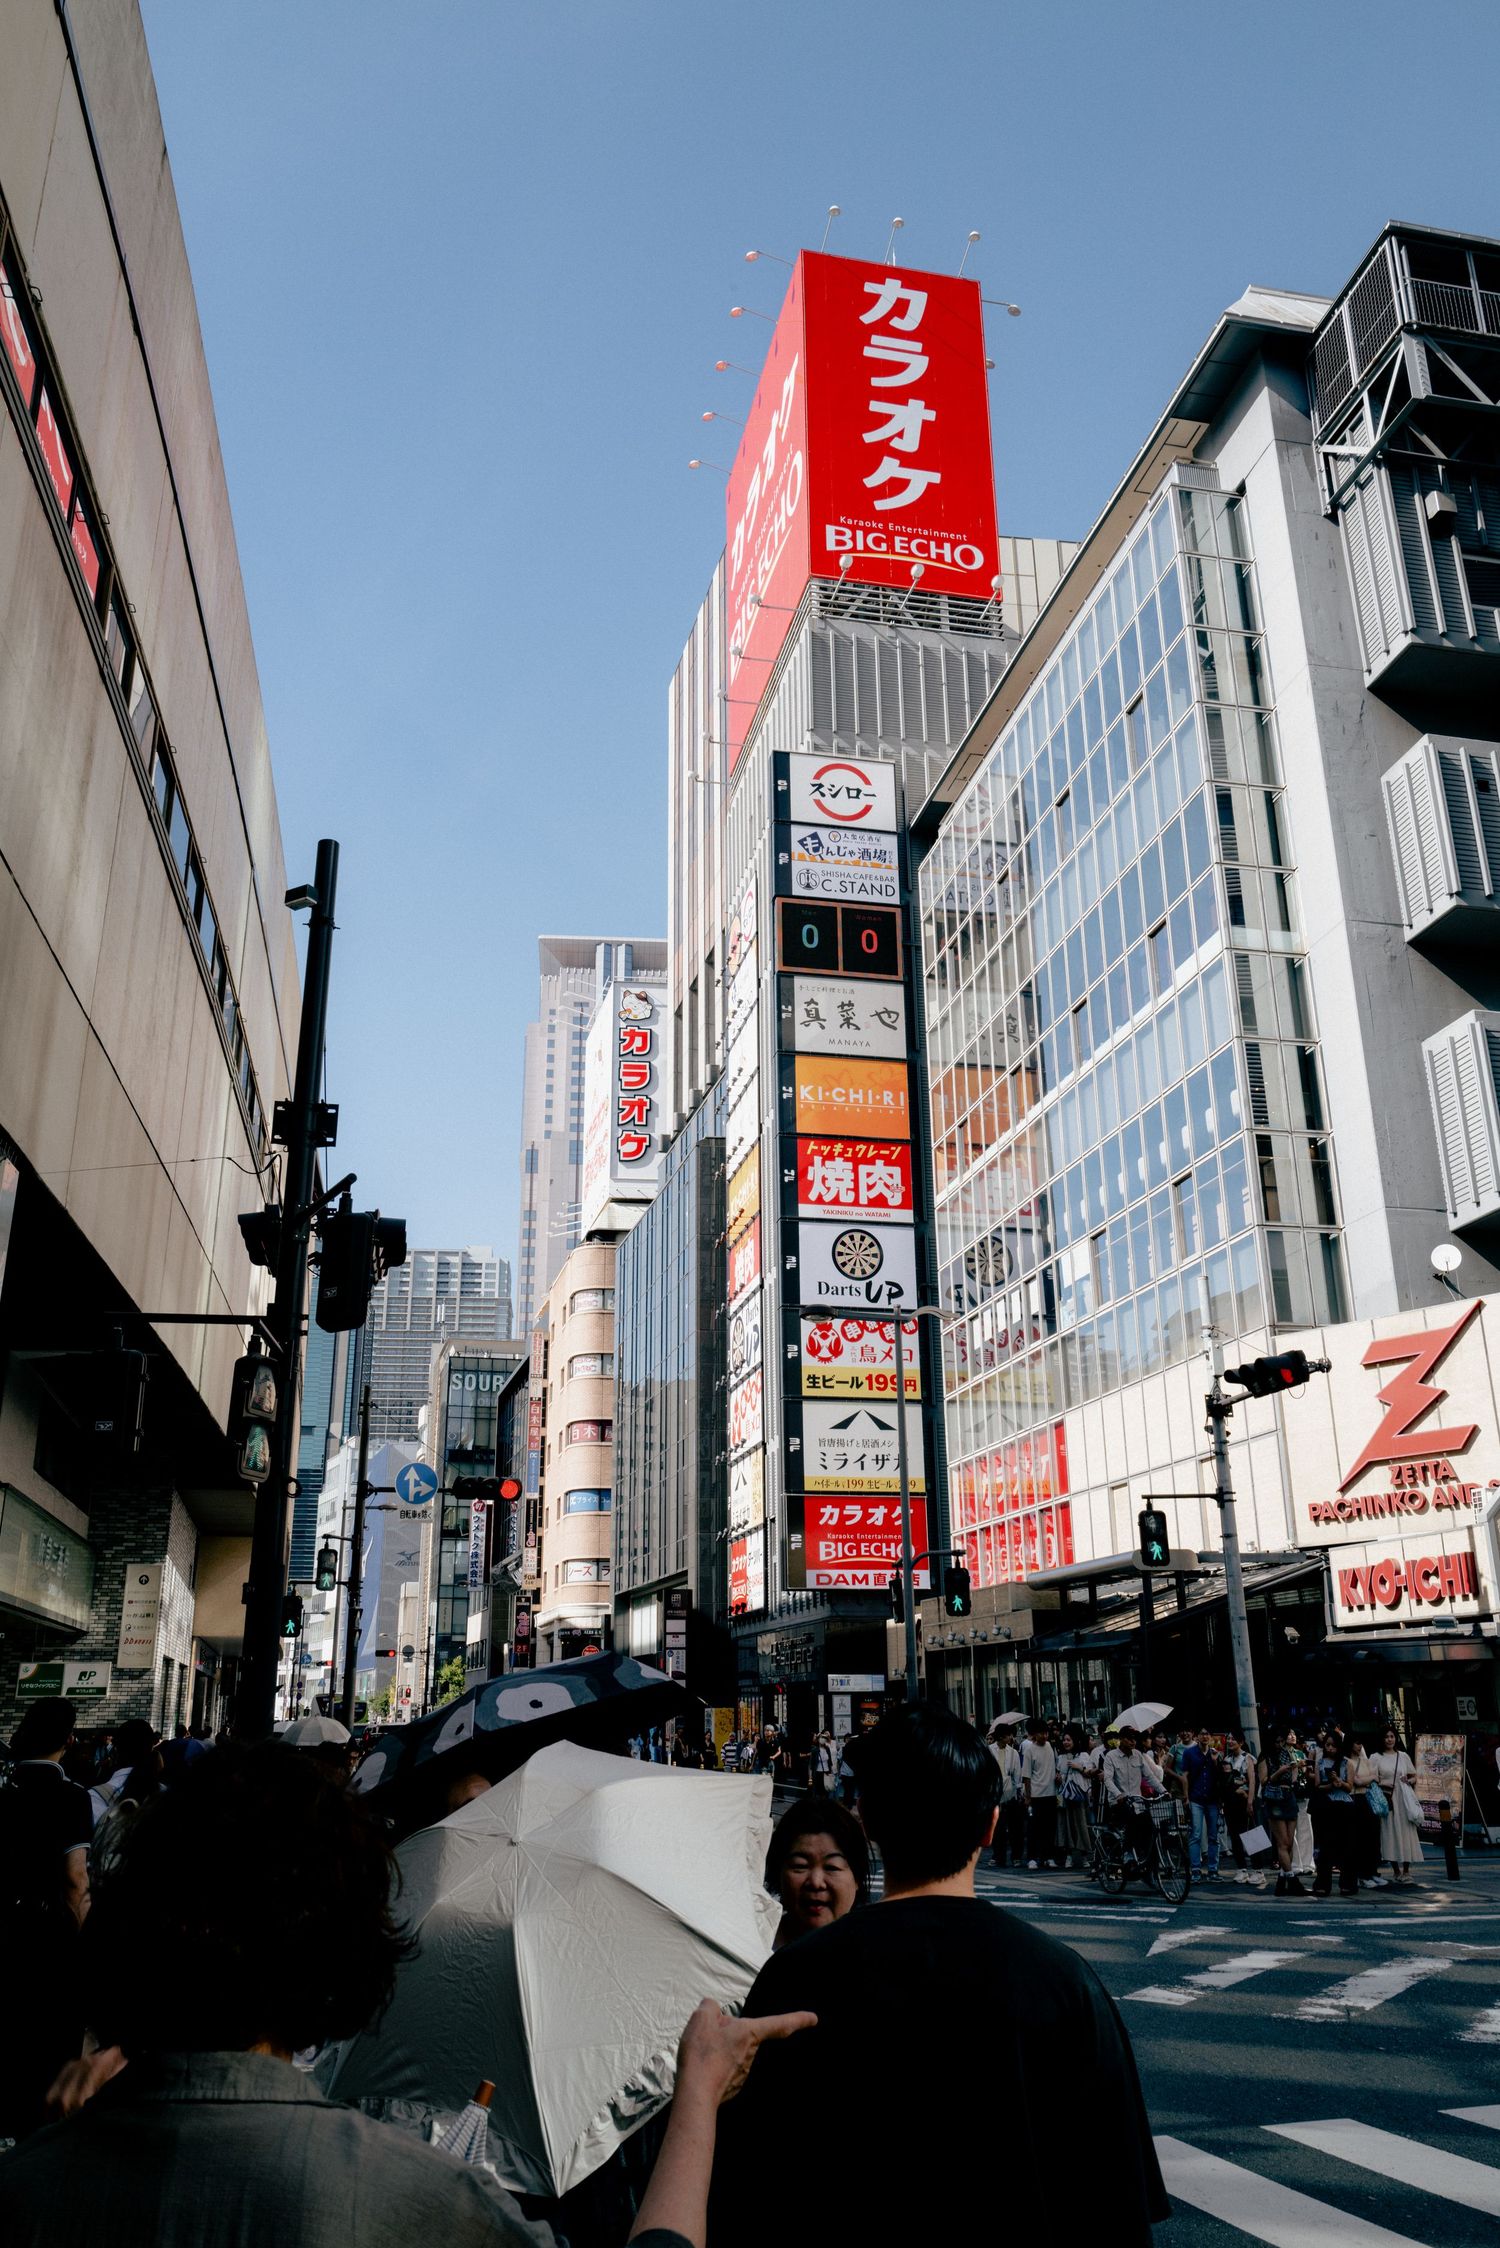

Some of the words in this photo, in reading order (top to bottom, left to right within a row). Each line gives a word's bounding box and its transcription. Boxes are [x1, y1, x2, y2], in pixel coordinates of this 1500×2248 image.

[858, 277, 942, 511] カラオケ
[731, 351, 799, 591] カラオケ
[839, 515, 884, 530] Karaoke
[888, 522, 968, 541] Entertainment
[826, 524, 888, 552] BIG
[894, 536, 985, 571] ECHO
[729, 577, 756, 687] BIG
[757, 450, 803, 595] ECHO
[808, 780, 878, 801] スシロー
[821, 869, 852, 880] SHISHA
[852, 873, 896, 883] CAFE&BAR
[821, 879, 896, 897] C.STAND
[801, 924, 819, 949] 0
[861, 929, 879, 954] 0
[828, 1038, 871, 1047] MANAYA
[617, 1025, 652, 1163] カラオケ
[806, 1141, 902, 1160] トッキュウレーン
[806, 1156, 904, 1206] 焼肉
[817, 1280, 862, 1297] Darts
[864, 1280, 904, 1305] UP
[860, 1344, 913, 1363] 鳥メロ
[1388, 1458, 1457, 1486] ZETTA
[399, 1509, 432, 1520] 自転車を除く
[818, 1504, 914, 1526] カラオケ
[1308, 1489, 1425, 1521] PACHINKO
[819, 1541, 857, 1562] BIG
[815, 1573, 870, 1586] DAM
